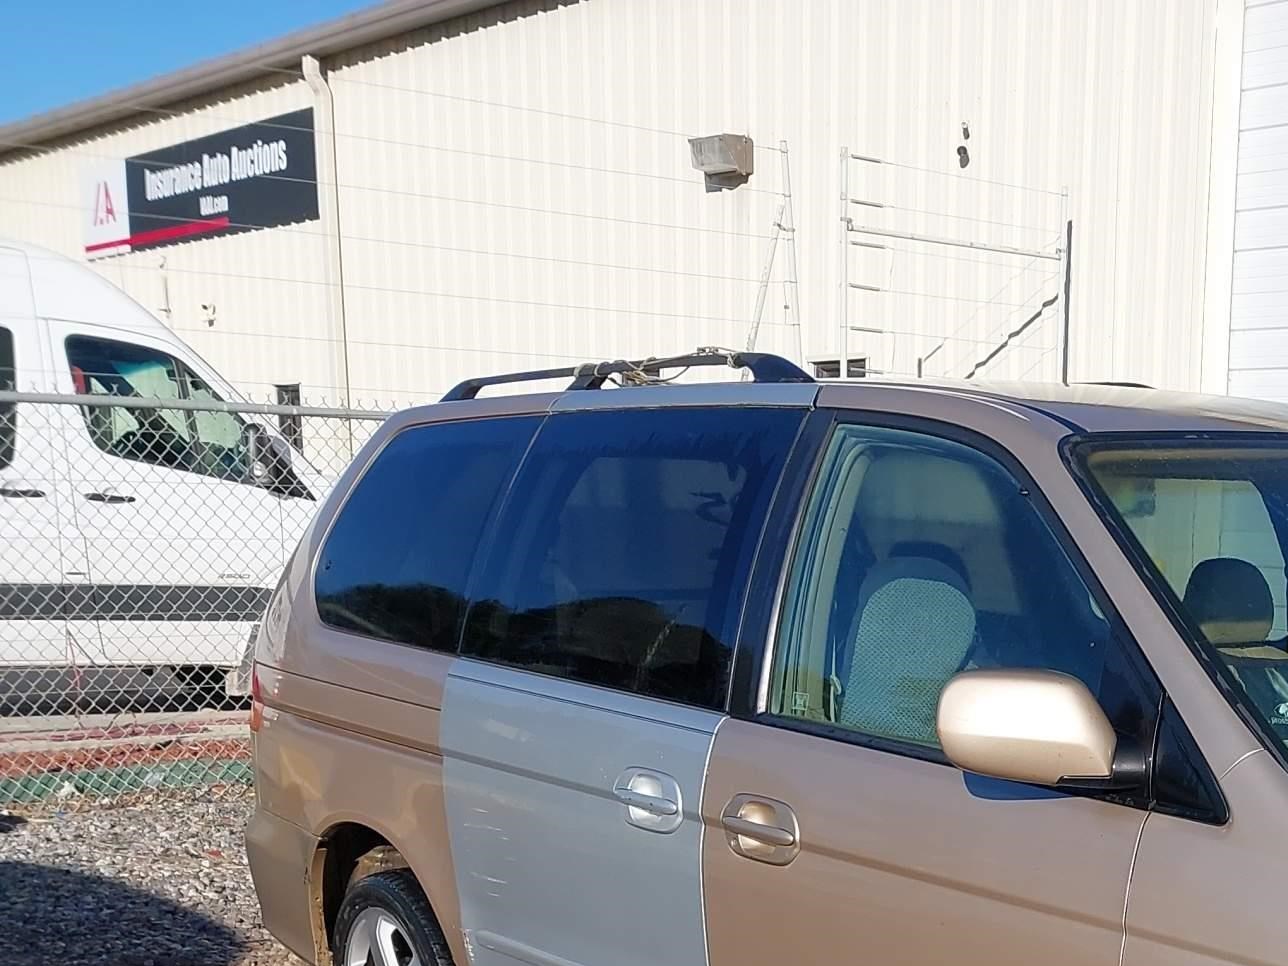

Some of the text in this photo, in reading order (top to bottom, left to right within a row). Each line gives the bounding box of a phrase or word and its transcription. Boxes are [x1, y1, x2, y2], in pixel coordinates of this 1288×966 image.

[144, 139, 287, 201] Insurance Auto Auctions
